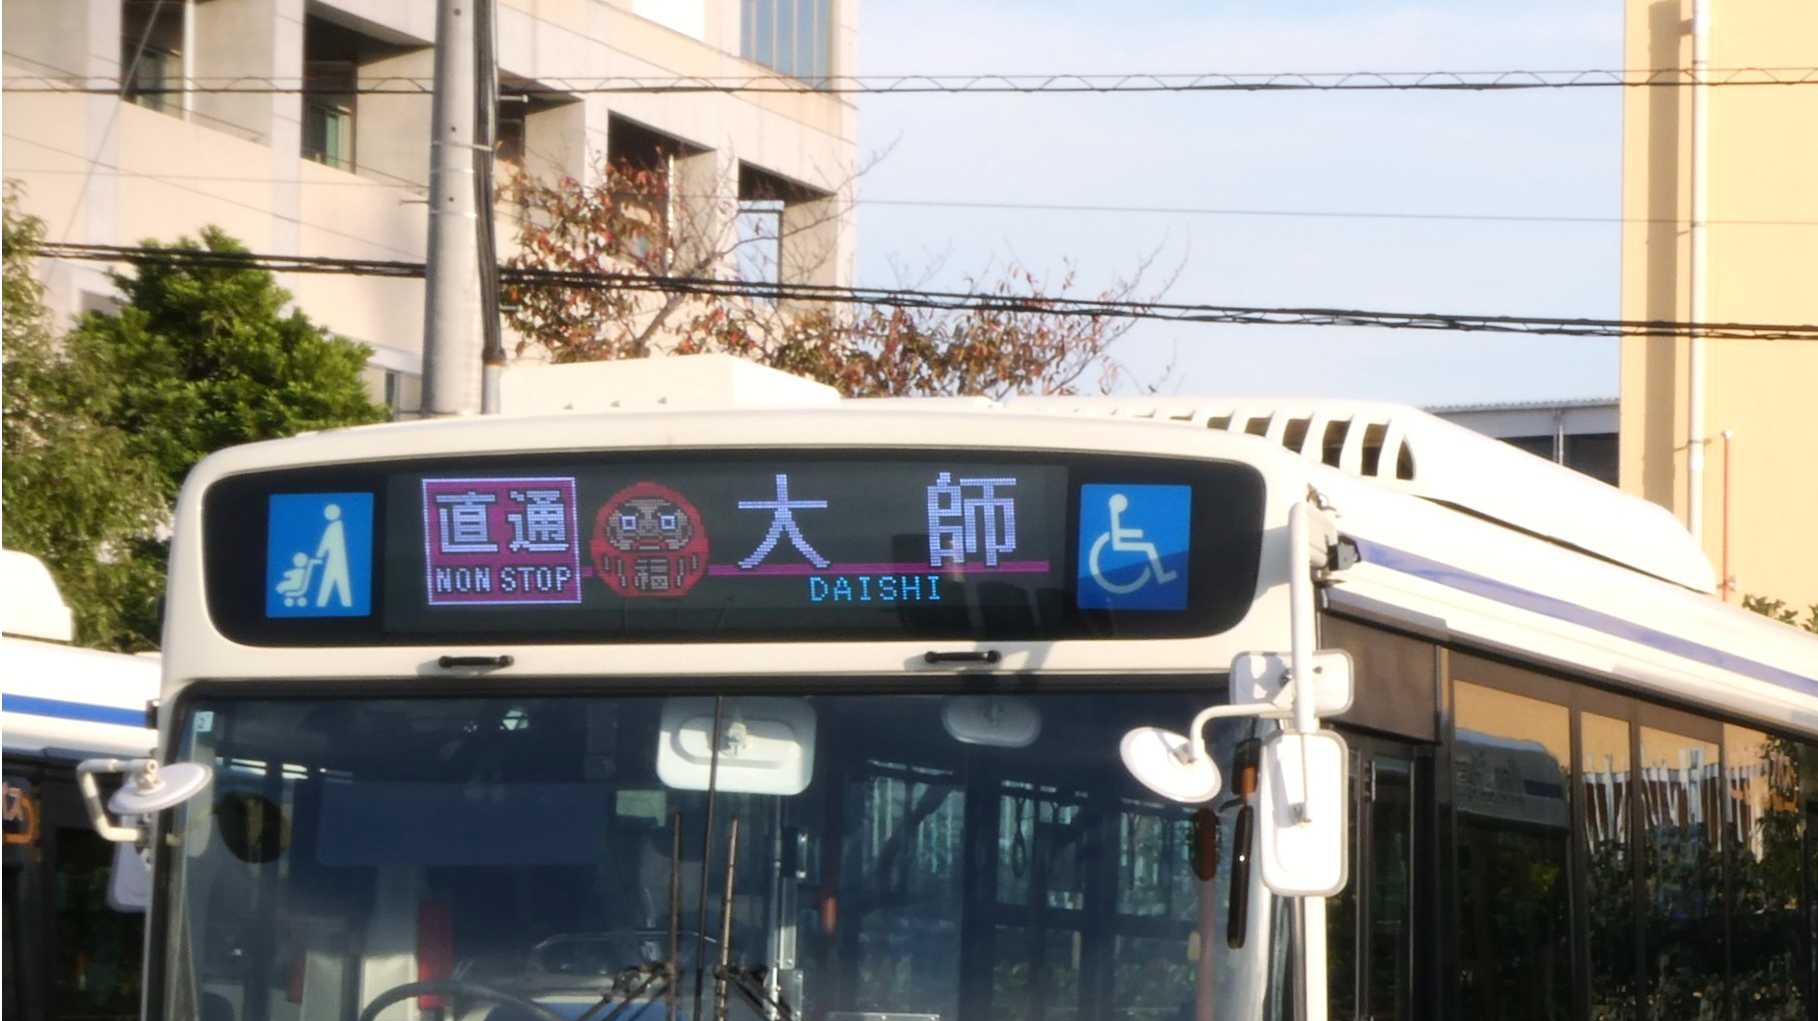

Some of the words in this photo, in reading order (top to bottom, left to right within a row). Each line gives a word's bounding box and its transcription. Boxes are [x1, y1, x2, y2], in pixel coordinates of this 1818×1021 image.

[436, 490, 569, 552] 直通
[737, 471, 1017, 569] 大師
[436, 566, 491, 593] NON
[501, 566, 571, 592] STOP
[809, 575, 942, 602] DAISHI
